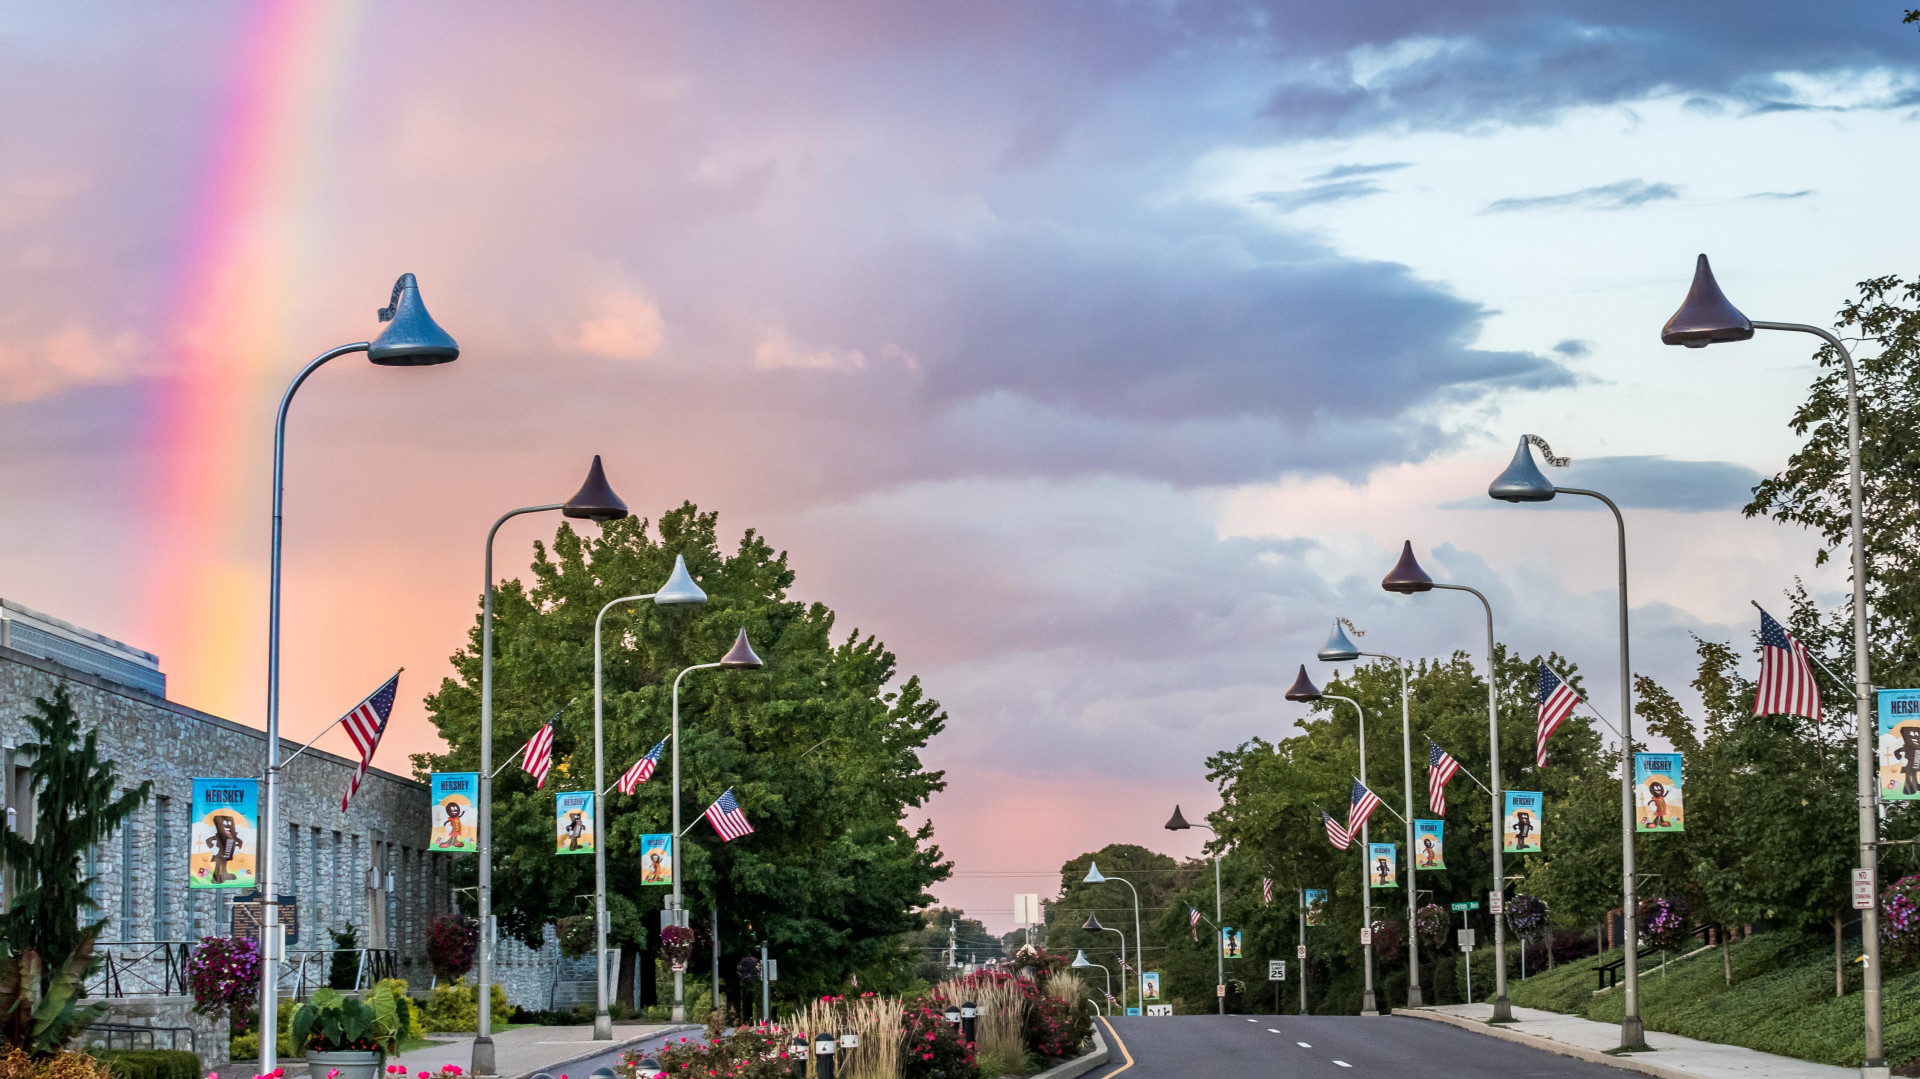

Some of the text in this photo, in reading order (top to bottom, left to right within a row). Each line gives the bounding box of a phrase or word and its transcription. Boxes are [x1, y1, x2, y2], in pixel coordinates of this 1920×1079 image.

[1531, 435, 1569, 467] HERSHEY
[1341, 617, 1366, 637] HERSHEY
[1644, 761, 1672, 771] HERSHEY
[441, 781, 469, 791] HERSHEY
[205, 789, 245, 803] HERSHEY
[564, 798, 586, 806] HERSHEY
[1512, 797, 1535, 806] HERSHEY
[1858, 871, 1867, 880] NO
[1270, 970, 1284, 979] 25
